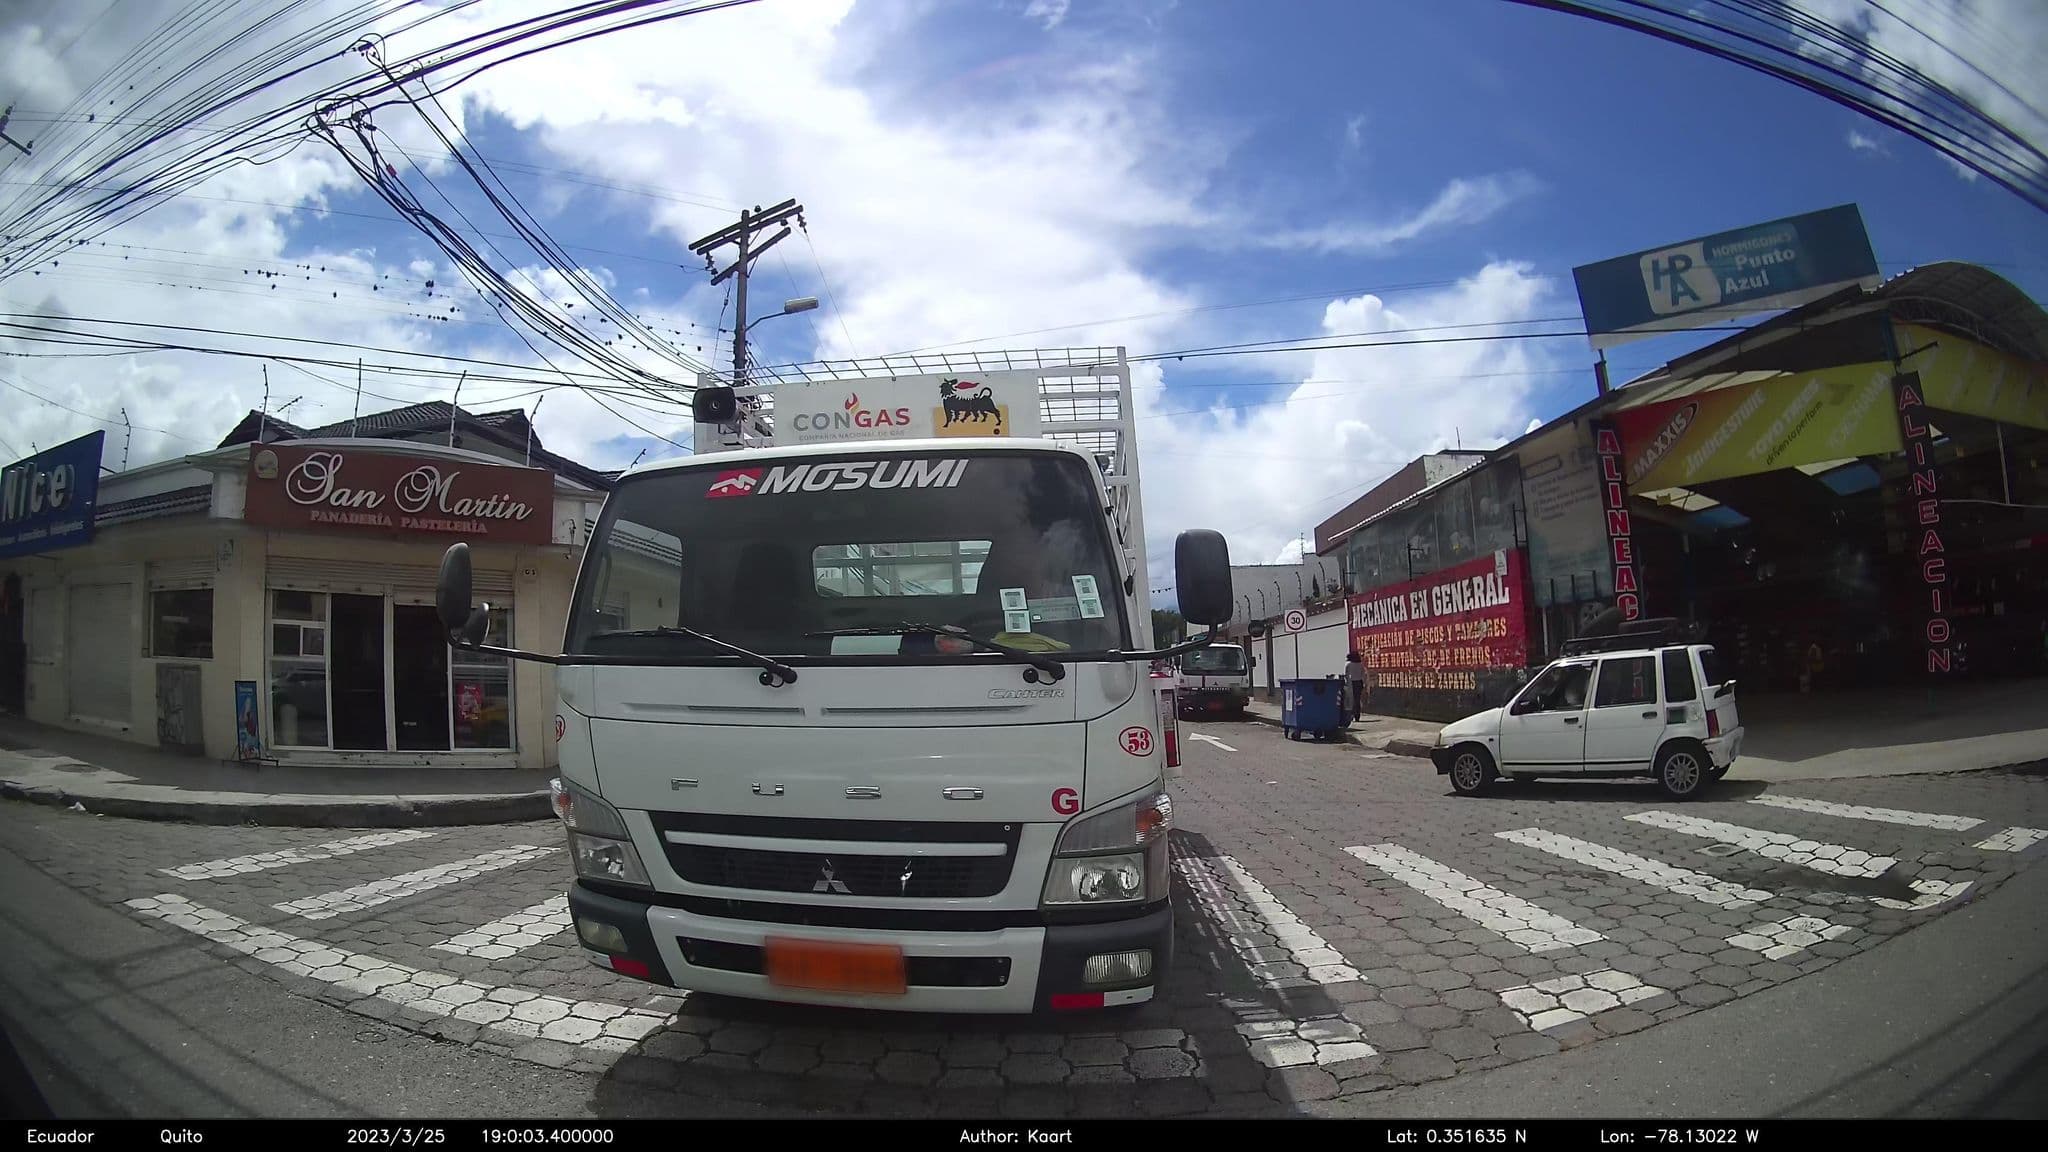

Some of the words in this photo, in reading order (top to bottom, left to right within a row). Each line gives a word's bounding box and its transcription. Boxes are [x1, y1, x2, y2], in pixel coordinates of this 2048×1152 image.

[1735, 249, 1795, 271] Punto
[1725, 269, 1769, 295] Azul
[793, 407, 911, 432] CONGAS
[1633, 412, 1688, 478] MAXXIS
[286, 452, 386, 508] San
[394, 465, 533, 521] Martin
[757, 459, 970, 495] MOSUMI
[310, 510, 393, 527] PANADERÍA
[400, 517, 488, 534] PASTELERÍA
[1899, 384, 1951, 674] ALINEACION
[1352, 594, 1408, 629] MECÁNICA
[1411, 589, 1429, 620] EN
[1432, 572, 1510, 617] GENERAL
[1290, 617, 1300, 625] 30
[1404, 629, 1415, 646] DE
[1446, 623, 1453, 642] Y
[1439, 648, 1451, 666] DE
[1454, 645, 1490, 666] FRENOS
[1437, 671, 1476, 690] ZAPATAS
[987, 688, 1065, 700] CANTER
[1127, 731, 1150, 752] 53
[671, 777, 985, 800] FUSO
[1051, 788, 1079, 815] G
